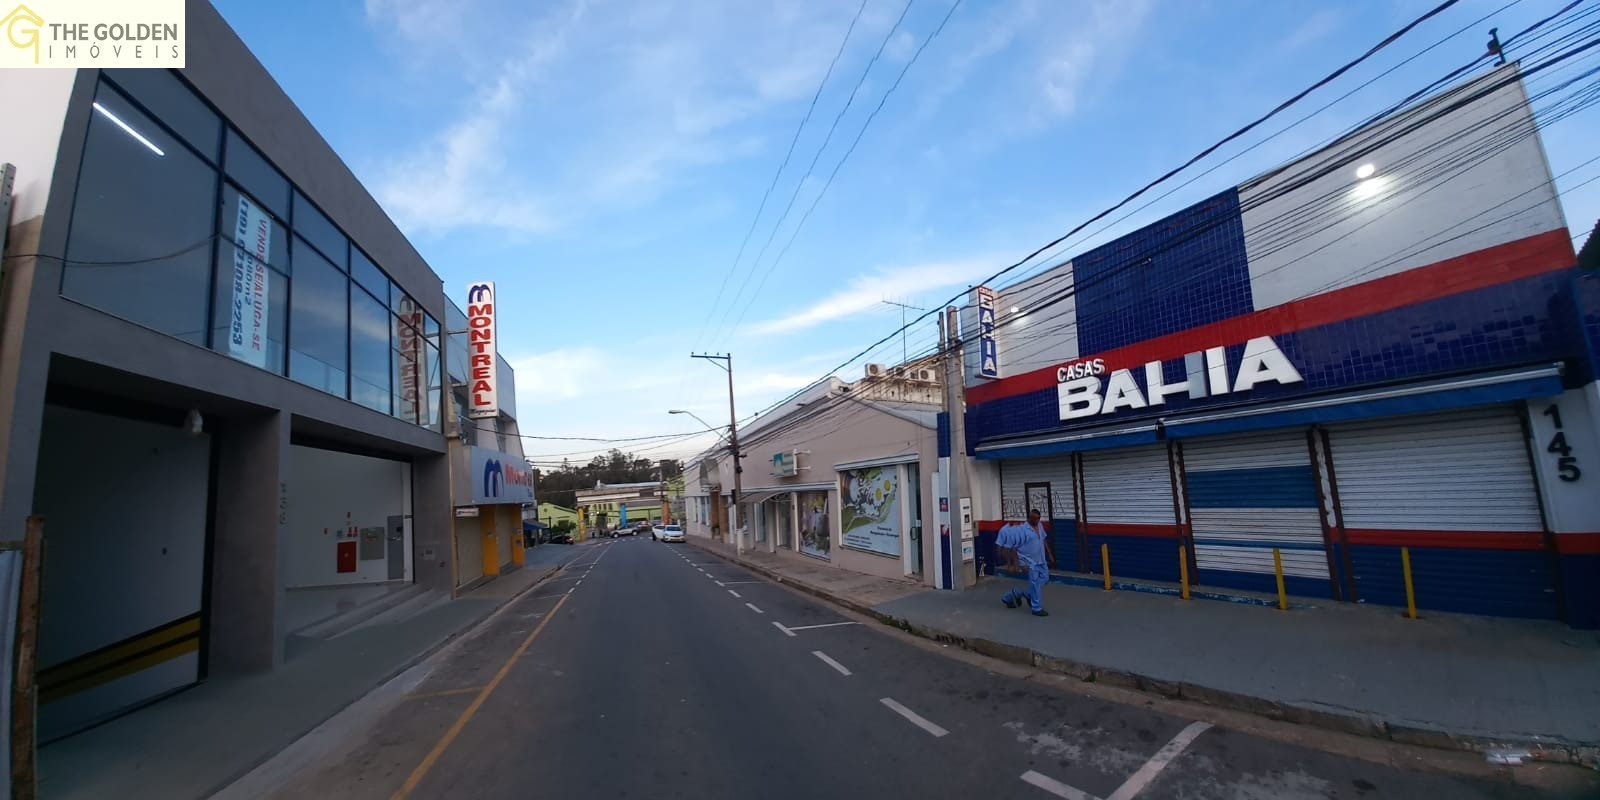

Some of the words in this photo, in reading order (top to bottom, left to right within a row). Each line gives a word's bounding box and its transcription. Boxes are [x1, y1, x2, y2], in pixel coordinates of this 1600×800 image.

[468, 303, 493, 407] MONTREAL
[1057, 358, 1106, 382] CASAS
[1057, 335, 1304, 421] BAHIA
[1544, 404, 1581, 483] 145
